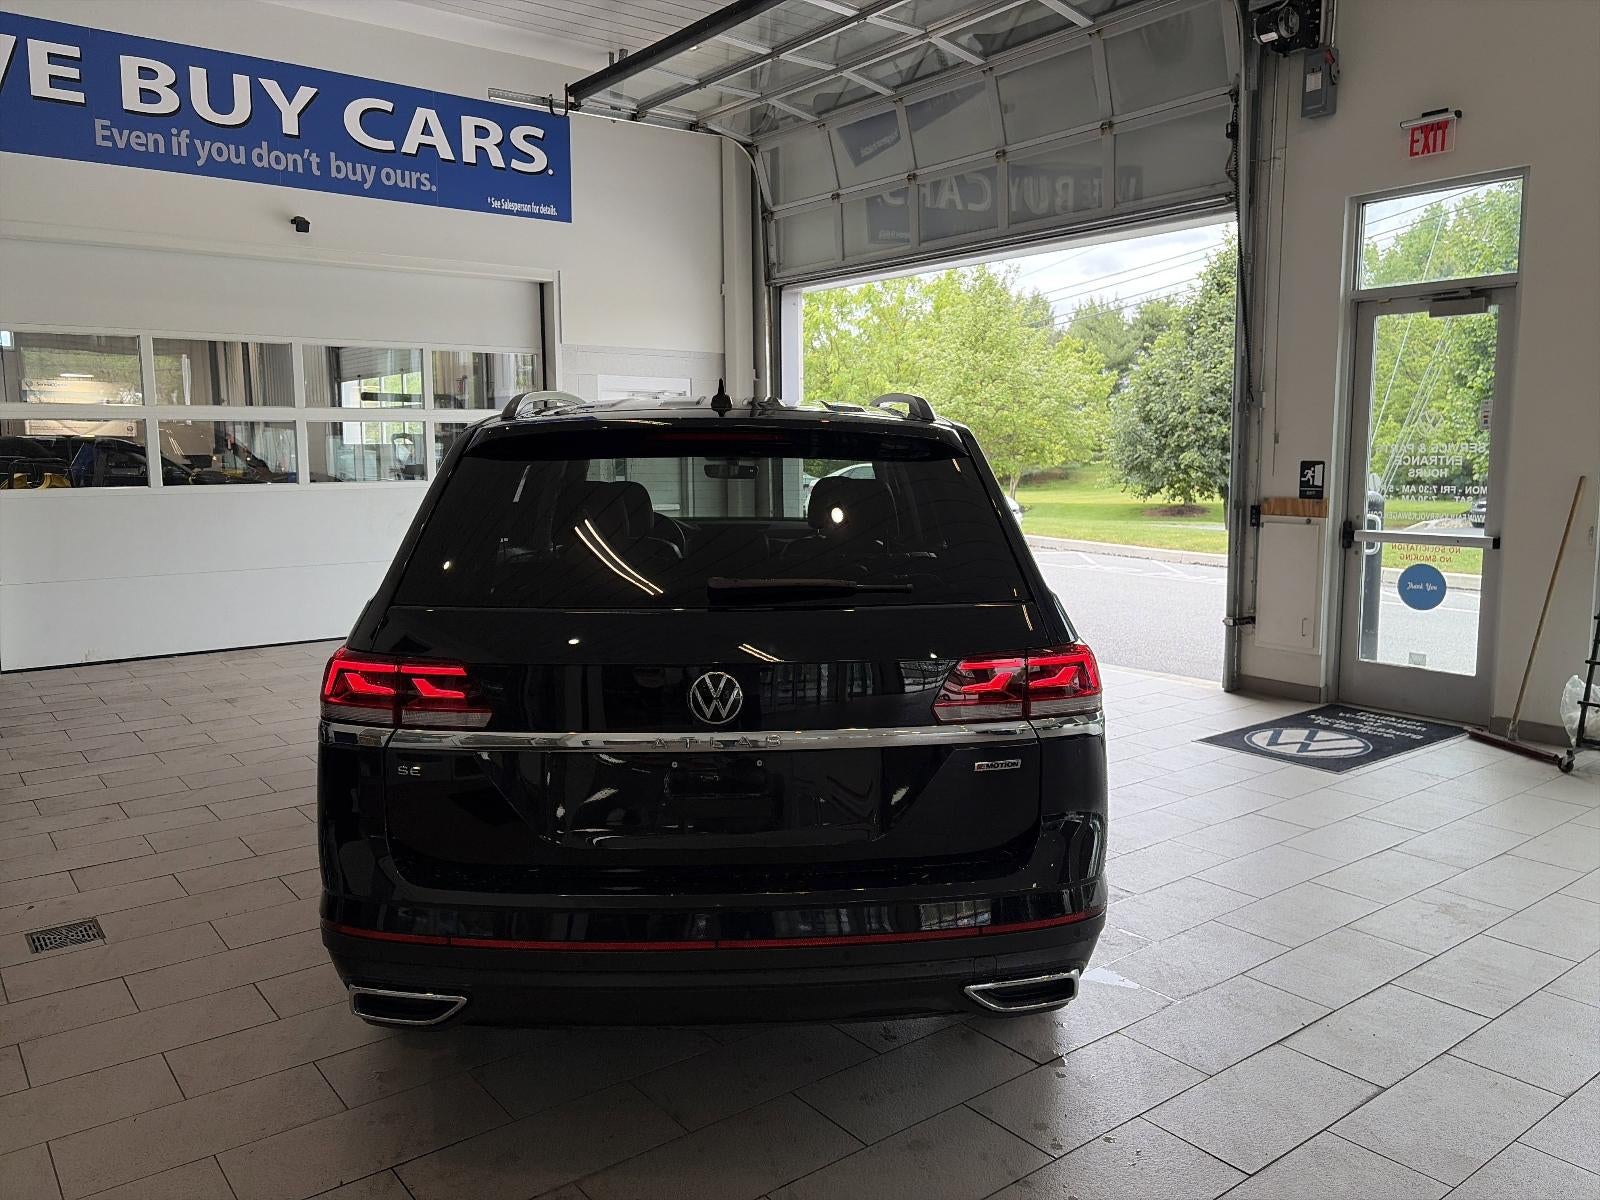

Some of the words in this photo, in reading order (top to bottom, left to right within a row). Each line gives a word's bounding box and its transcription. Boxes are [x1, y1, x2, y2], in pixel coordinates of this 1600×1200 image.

[0, 33, 86, 106] E
[119, 54, 318, 139] BUY
[343, 97, 555, 177] CARS.
[1409, 120, 1450, 158] EXIT
[94, 117, 166, 154] Even
[171, 127, 190, 157] if
[194, 138, 246, 167] you
[251, 141, 321, 176] don't
[329, 151, 376, 190] buy
[380, 167, 437, 192] ours.
[491, 197, 501, 208] See
[501, 199, 531, 213] Salesperson
[540, 203, 558, 216] details.
[1406, 581, 1423, 590] Thank
[1425, 582, 1438, 592] You
[651, 735, 783, 749] ATLAS
[397, 765, 421, 777] SE
